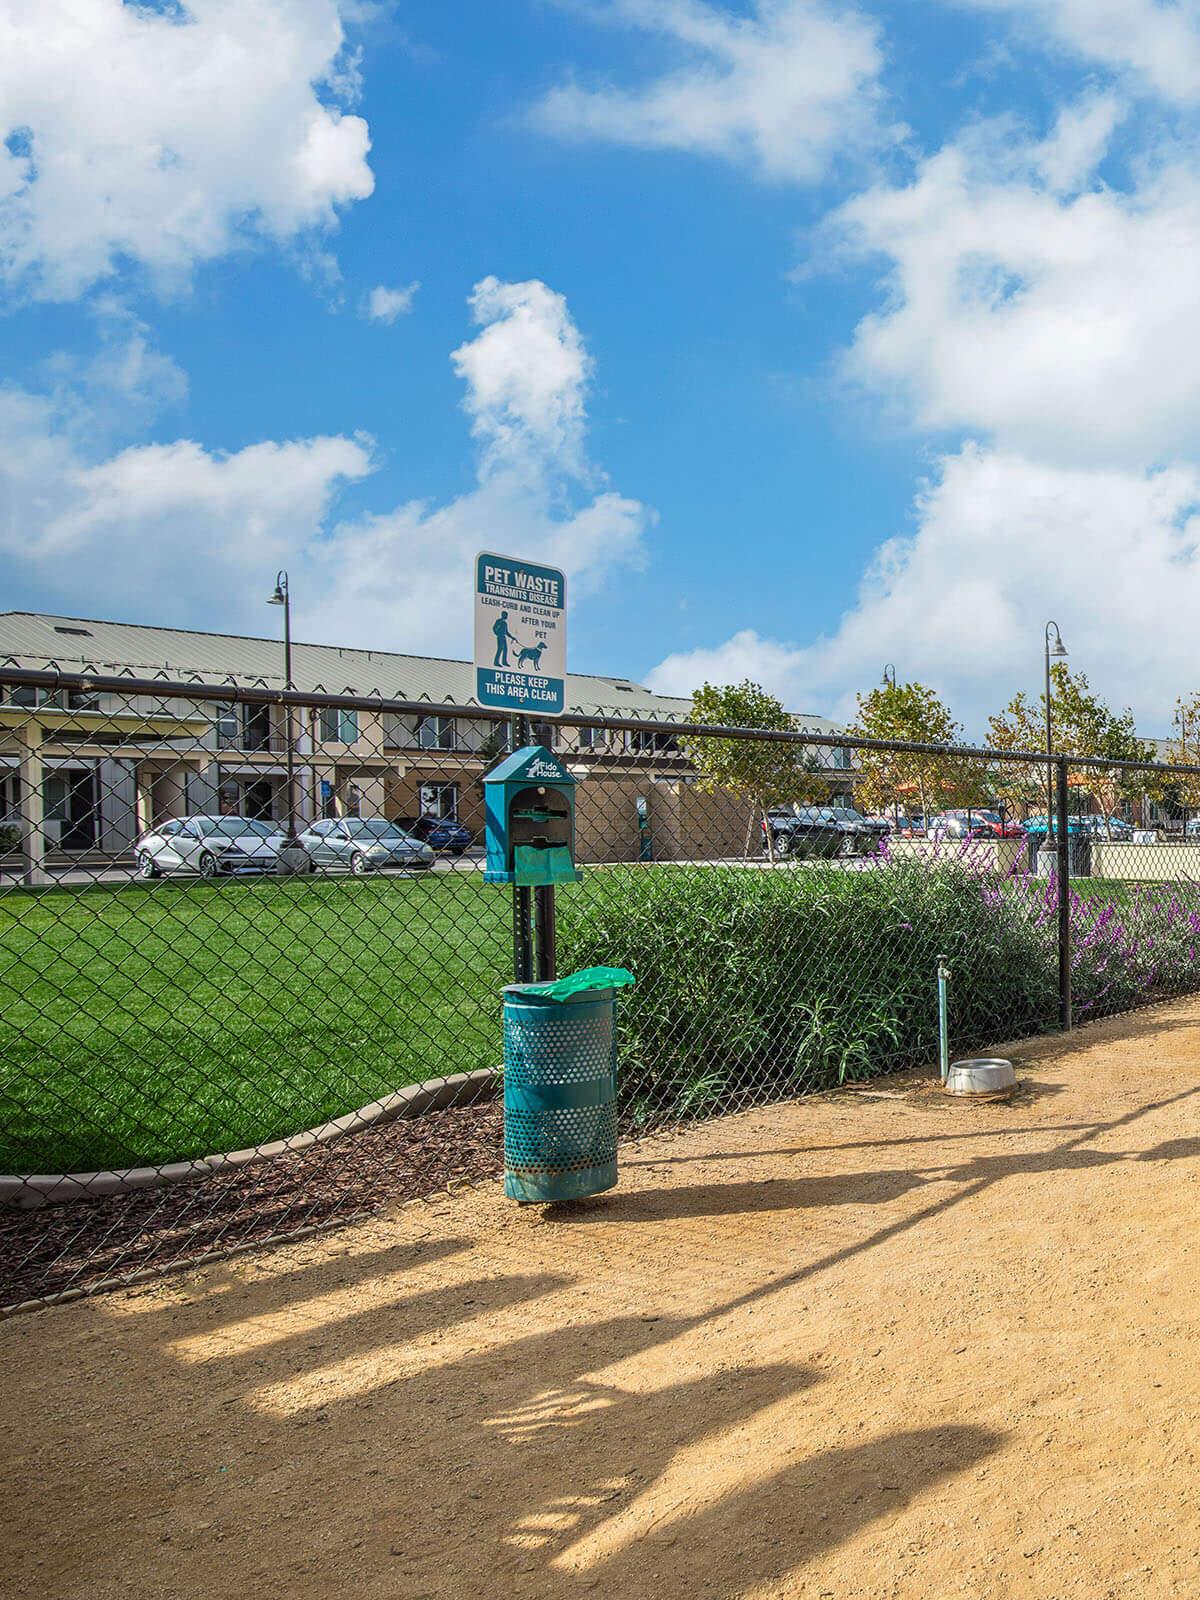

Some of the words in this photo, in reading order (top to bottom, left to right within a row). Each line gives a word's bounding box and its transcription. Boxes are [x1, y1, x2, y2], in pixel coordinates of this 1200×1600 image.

[485, 565, 511, 585] PET
[514, 572, 559, 595] WASTE
[485, 583, 528, 600] TRANSMITS
[528, 591, 558, 607] DISEASE
[481, 596, 518, 610] LEASH-CURB
[520, 604, 532, 613] AND
[533, 607, 550, 617] CLEAN
[521, 616, 540, 628] AFTER
[541, 619, 556, 629] YOUR
[535, 630, 547, 639] PET
[495, 672, 526, 687] PLEASE
[528, 676, 549, 689] KEEP
[485, 682, 505, 695] THIS
[507, 685, 529, 699] AREA
[531, 689, 558, 702] CLEAN
[536, 769, 561, 778] House
[540, 761, 557, 771] Fido
